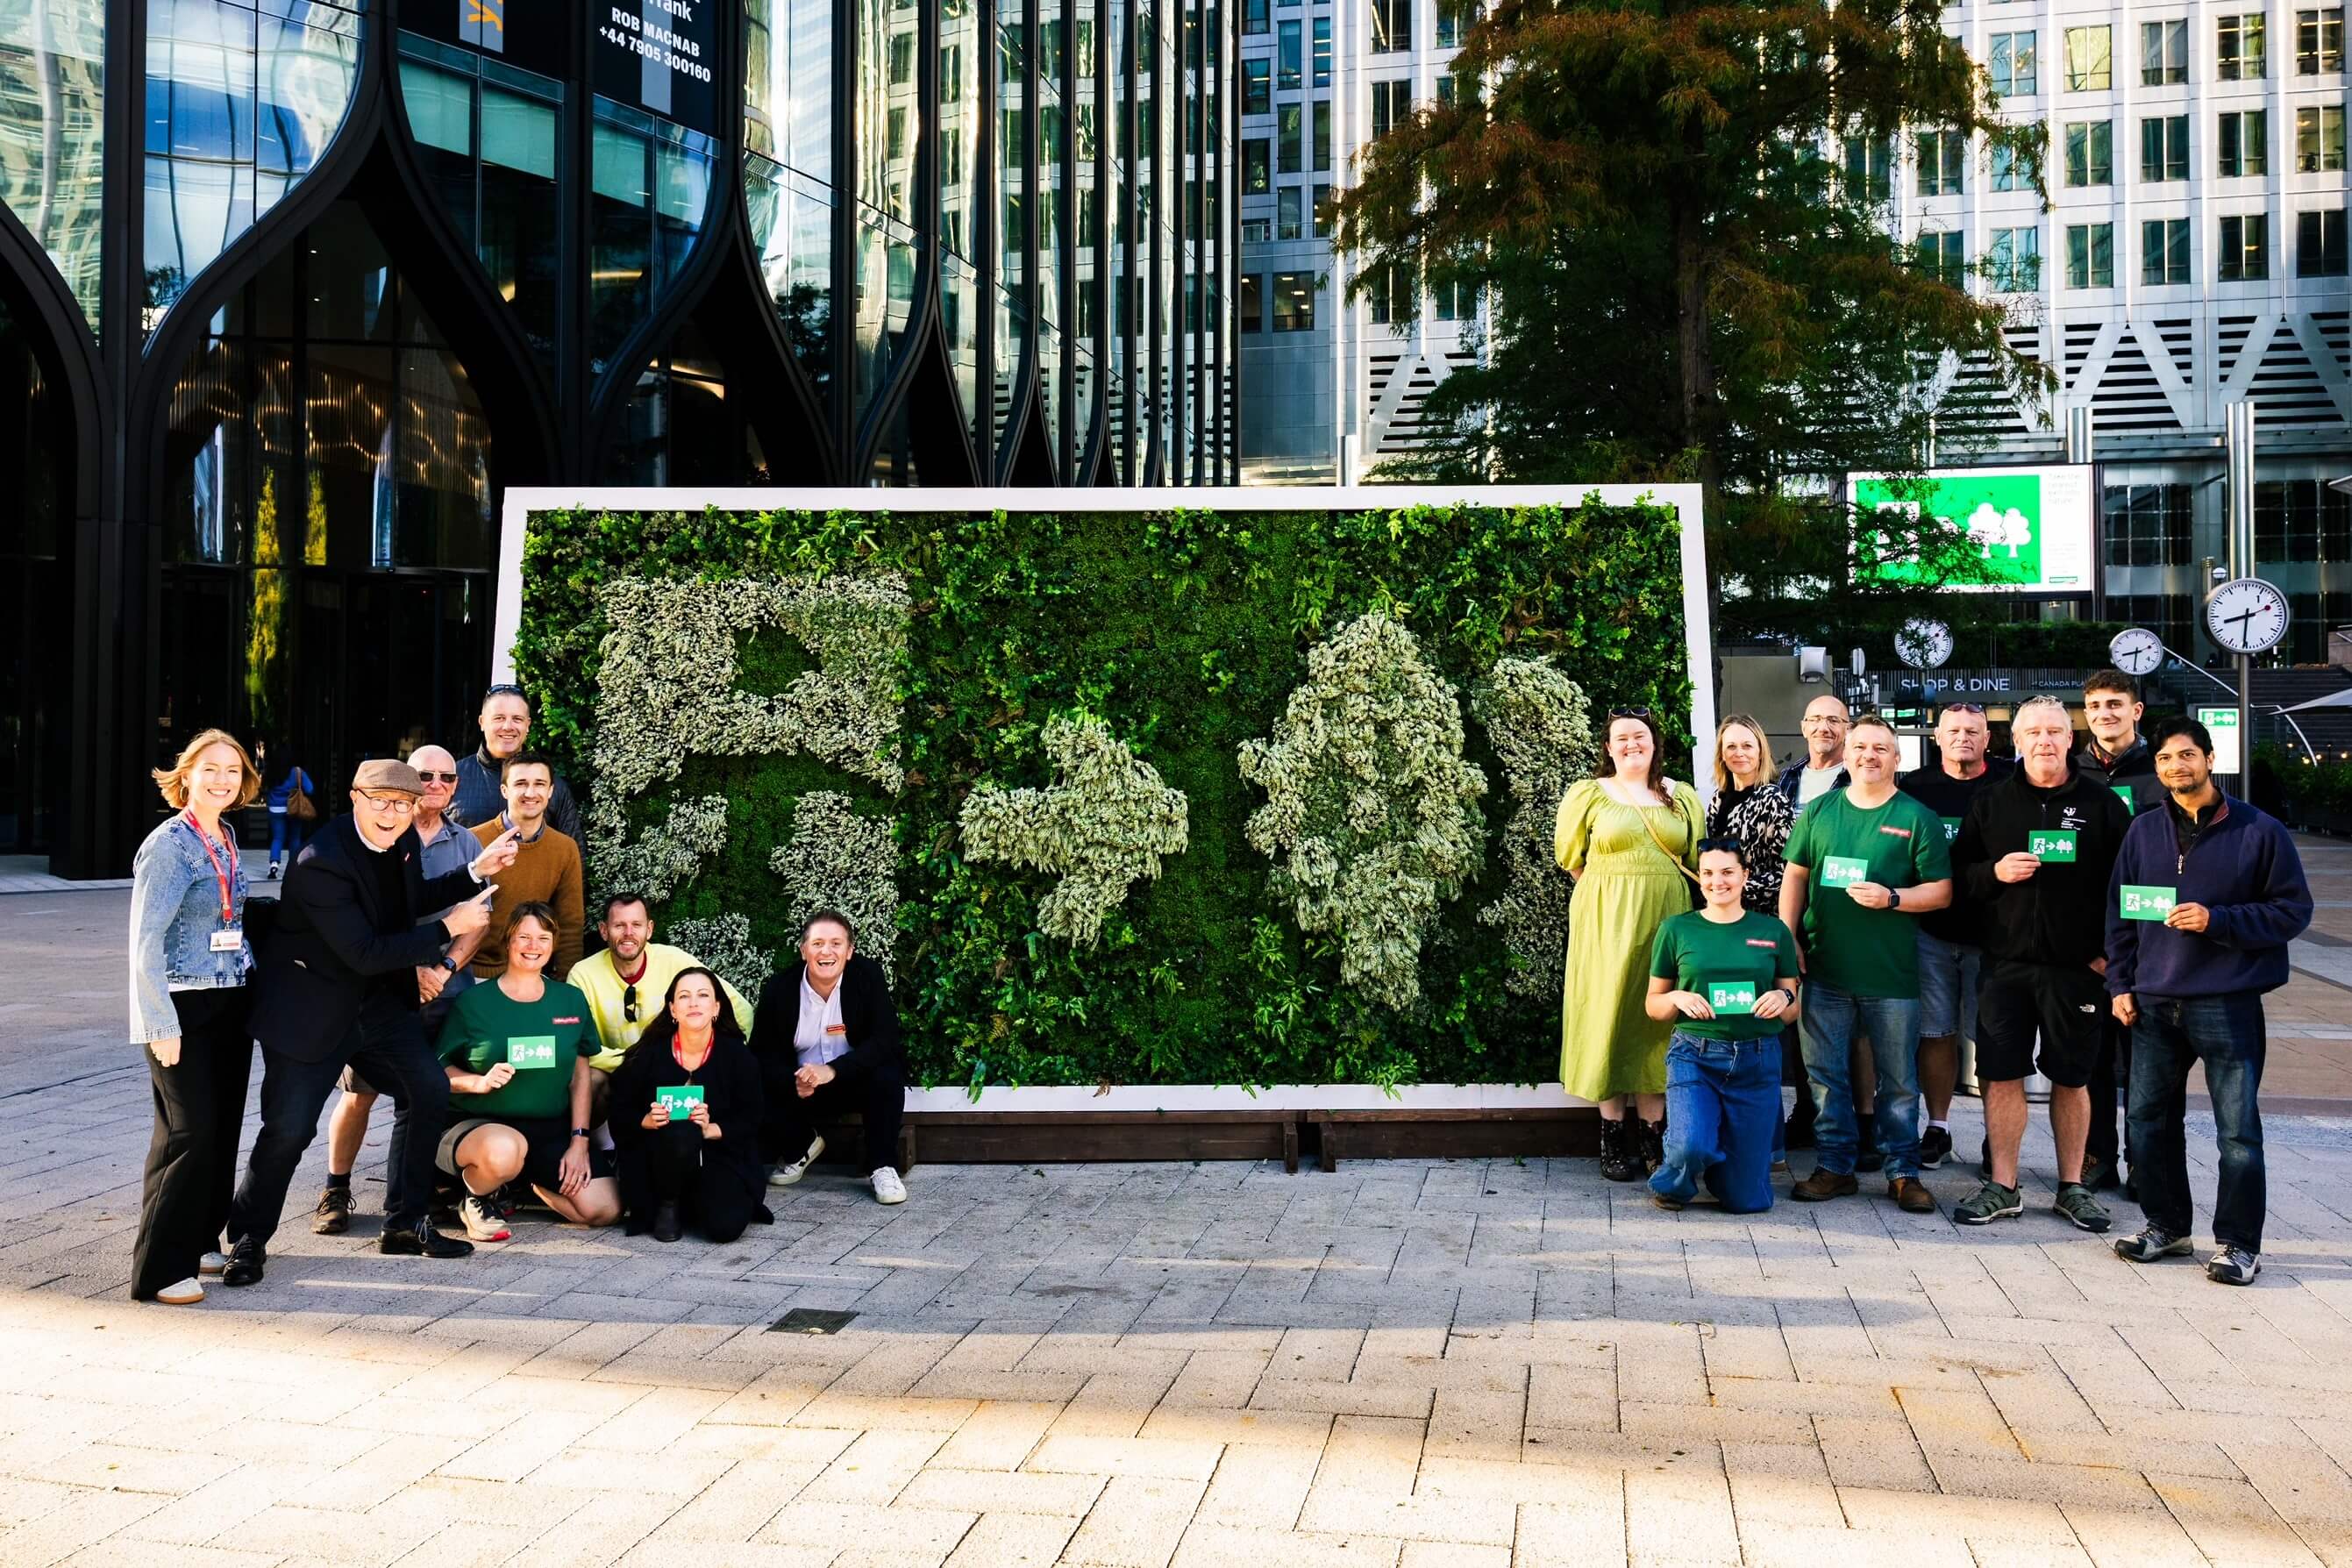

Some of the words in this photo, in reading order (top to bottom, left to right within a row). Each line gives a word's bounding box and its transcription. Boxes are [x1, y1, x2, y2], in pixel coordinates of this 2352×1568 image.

[599, 25, 626, 47] +44
[628, 35, 661, 62] 7905
[664, 51, 711, 83] 300160
[611, 6, 640, 32] ROB
[644, 20, 700, 57] MACNAB
[1954, 679, 1965, 692] &
[1971, 679, 2010, 691] DINE
